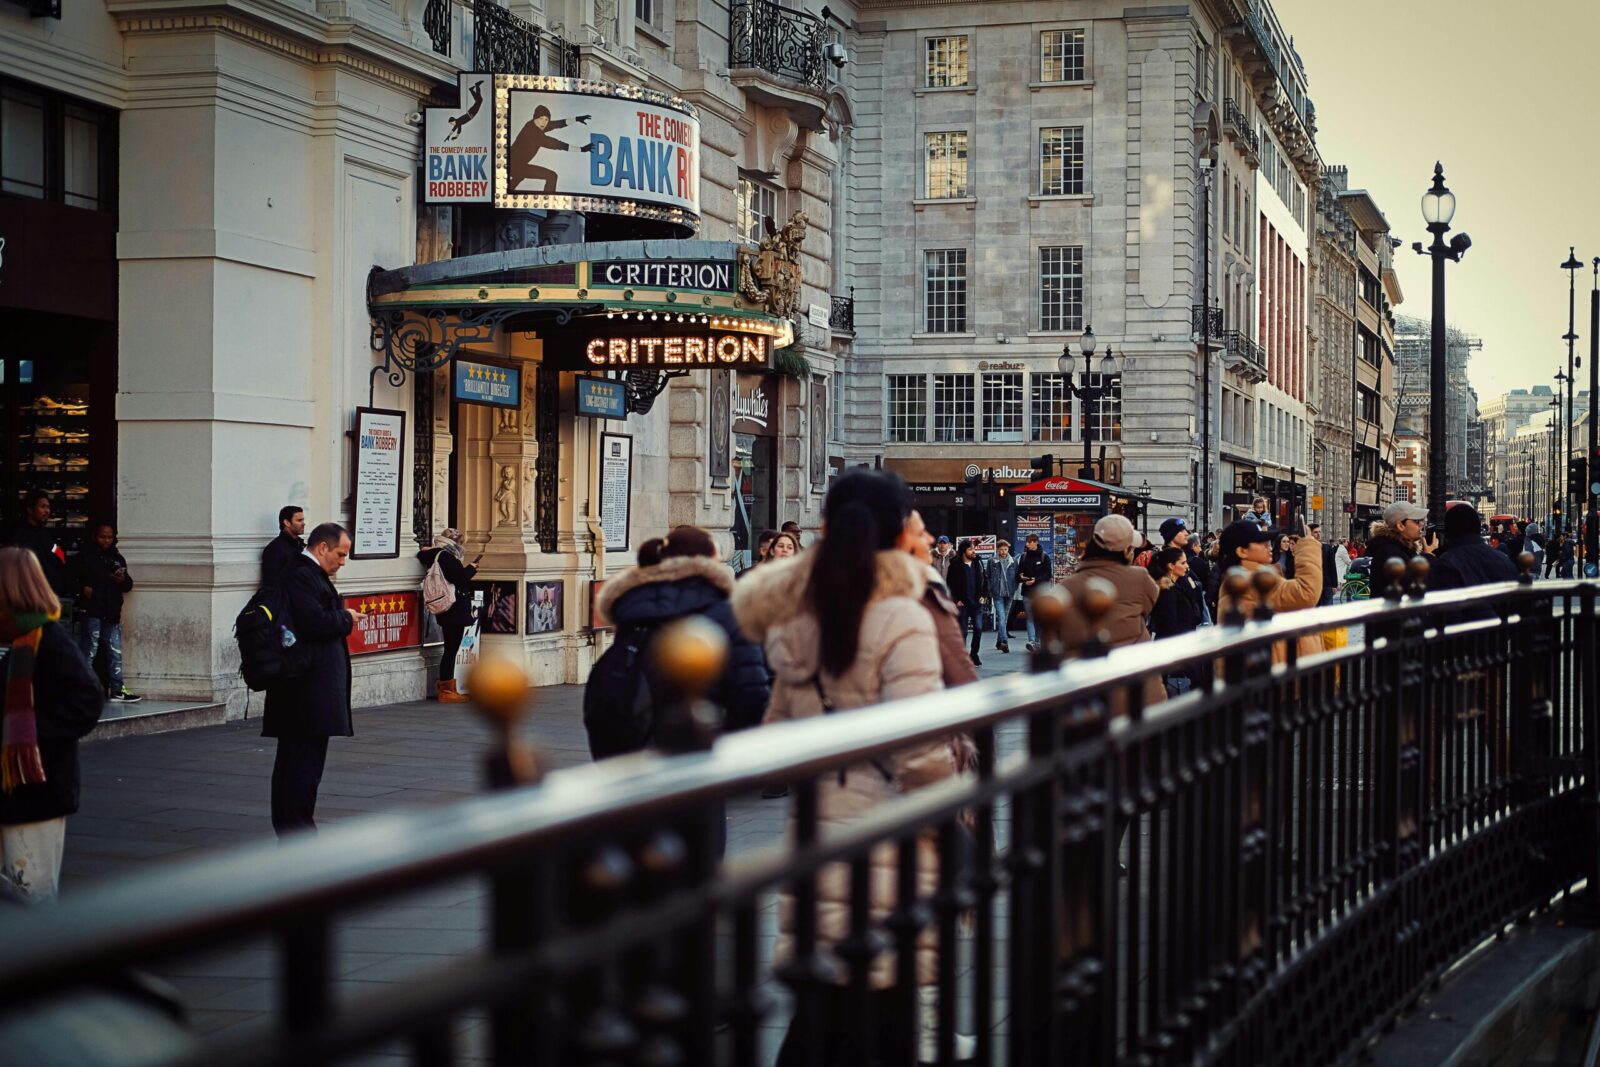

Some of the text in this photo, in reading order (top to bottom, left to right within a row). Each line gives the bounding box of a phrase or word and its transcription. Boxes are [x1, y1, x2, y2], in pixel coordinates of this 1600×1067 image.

[637, 111, 661, 139] THE
[430, 146, 440, 154] THE
[441, 146, 463, 154] COMEDY
[429, 154, 488, 180] BANK
[590, 133, 673, 196] BANK
[429, 181, 488, 197] ROBBERY
[606, 264, 729, 289] CRITERION
[586, 334, 766, 364] CRITERION
[361, 435, 398, 451] BANK ROBBERY
[369, 615, 375, 630] IS
[376, 614, 386, 629] THE
[386, 612, 409, 628] FUNNIEST
[364, 630, 379, 645] SHOW
[379, 630, 385, 643] IN
